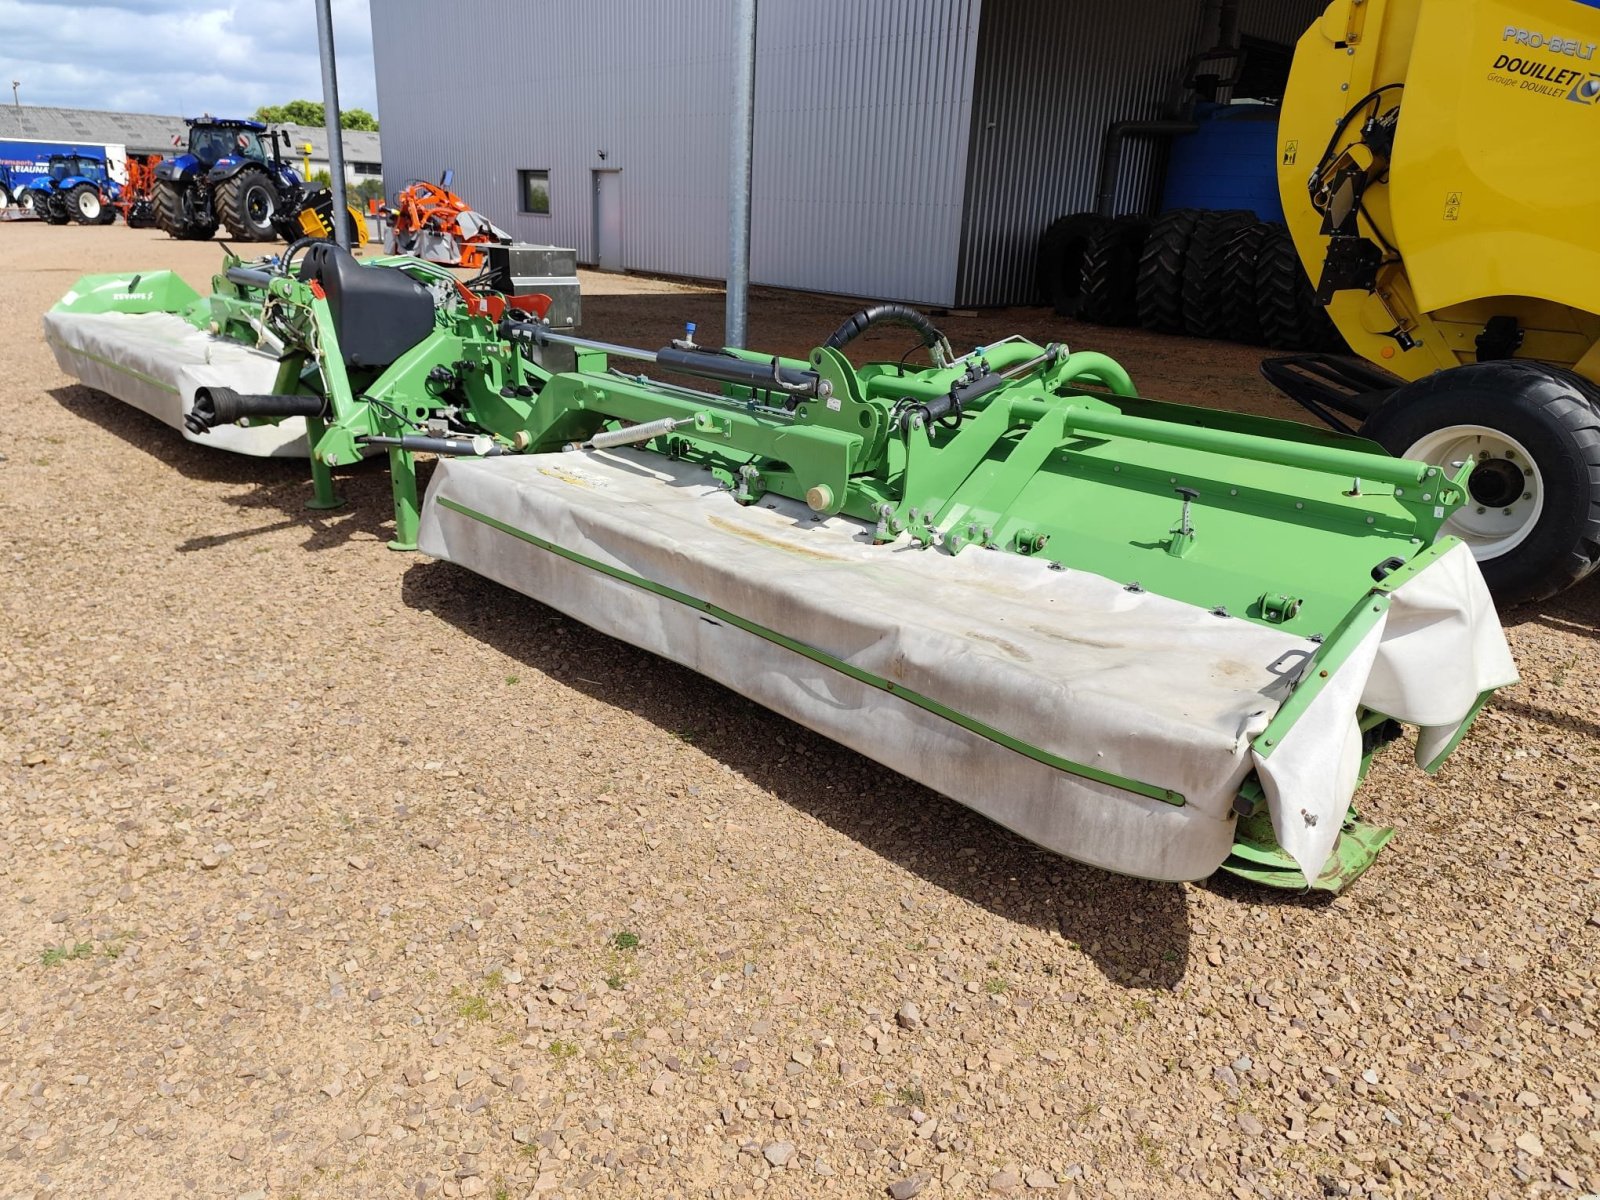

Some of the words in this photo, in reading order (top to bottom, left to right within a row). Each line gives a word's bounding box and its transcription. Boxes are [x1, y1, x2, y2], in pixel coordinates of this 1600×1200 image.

[1503, 25, 1597, 61] PRO-BELT
[1487, 72, 1518, 88] Groupe
[1520, 80, 1566, 98] DOUILLET
[1493, 54, 1581, 86] DOUILLET
